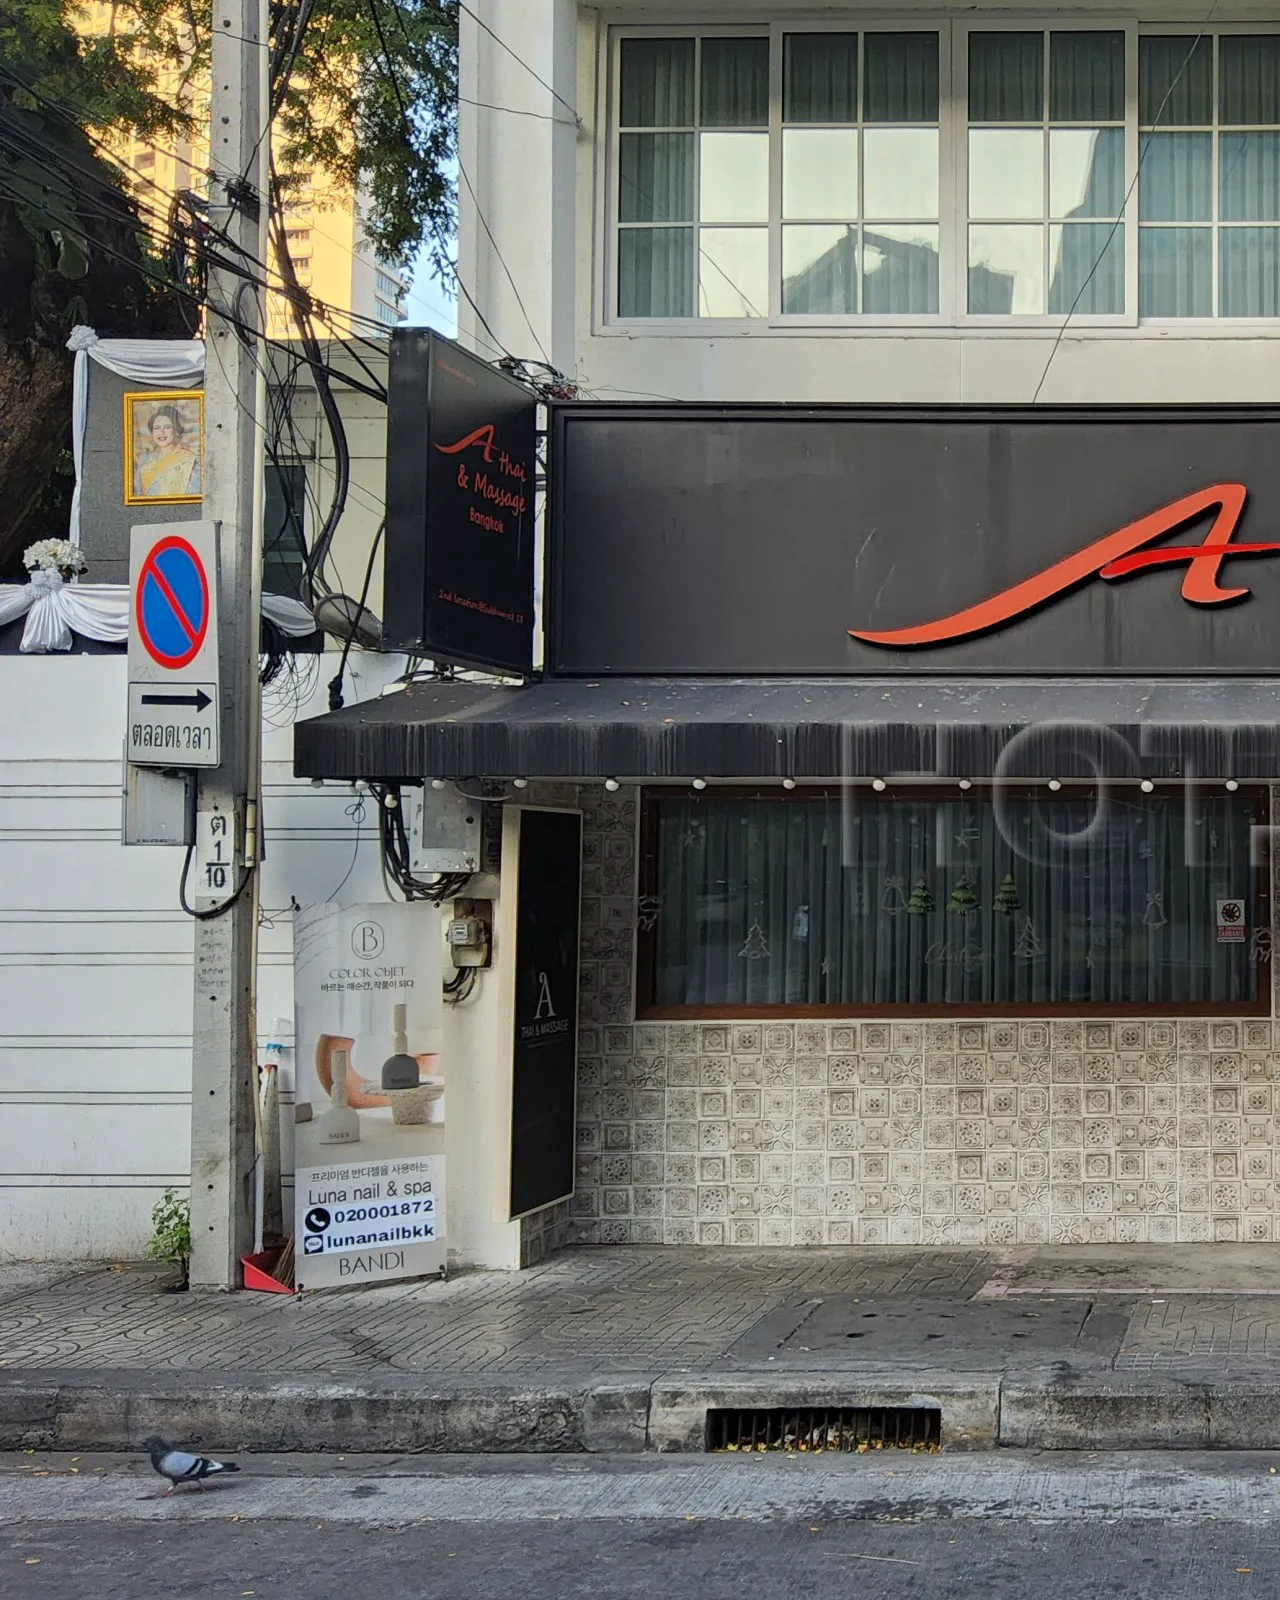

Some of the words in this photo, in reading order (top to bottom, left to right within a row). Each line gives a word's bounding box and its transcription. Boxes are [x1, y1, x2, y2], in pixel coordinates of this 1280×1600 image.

[499, 450, 527, 482] thai
[457, 463, 469, 489] &
[474, 471, 527, 517] Massage
[469, 507, 504, 534] Bangkok
[132, 723, 212, 751] ตลอดเวลา
[205, 866, 226, 889] 10
[328, 967, 372, 980] COLOR
[320, 982, 346, 993] 바르는
[533, 971, 557, 1020] A
[310, 1168, 350, 1183] 프리미엄
[351, 1164, 390, 1180] 반디젤을
[390, 1161, 430, 1176] 사용하는
[308, 1189, 348, 1207] Luna
[352, 1182, 381, 1202] nail
[386, 1179, 399, 1198] &
[403, 1180, 433, 1198] spa
[333, 1199, 435, 1224] 020001872
[326, 1223, 435, 1249] lunanailbkk
[338, 1250, 405, 1277] BANDI
